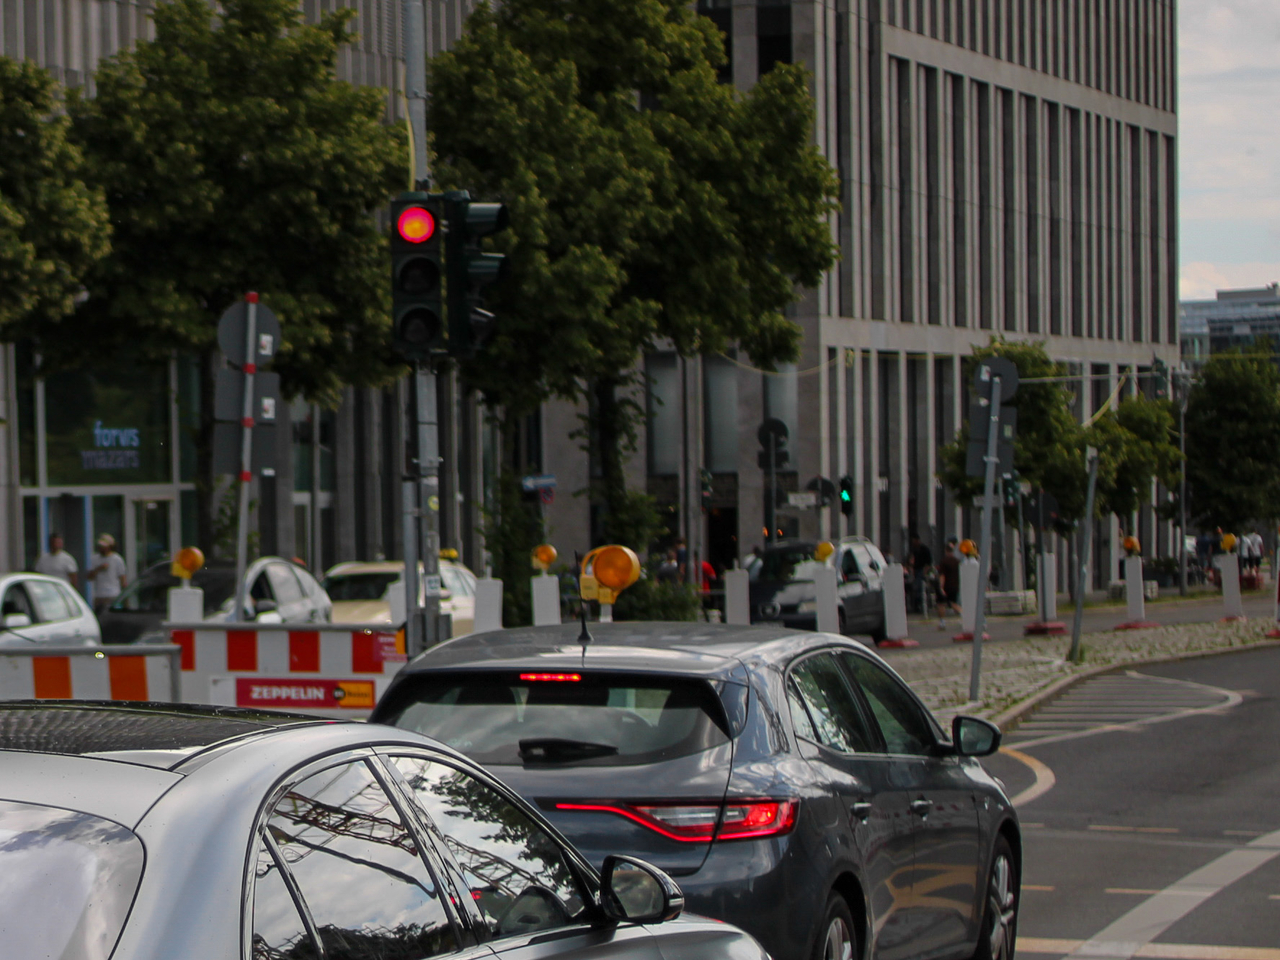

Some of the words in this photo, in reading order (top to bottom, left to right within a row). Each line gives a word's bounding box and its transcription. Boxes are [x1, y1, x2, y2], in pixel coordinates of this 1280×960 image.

[94, 420, 139, 447] forvis
[81, 451, 139, 470] mazars
[251, 686, 325, 700] ZEPPELIN
